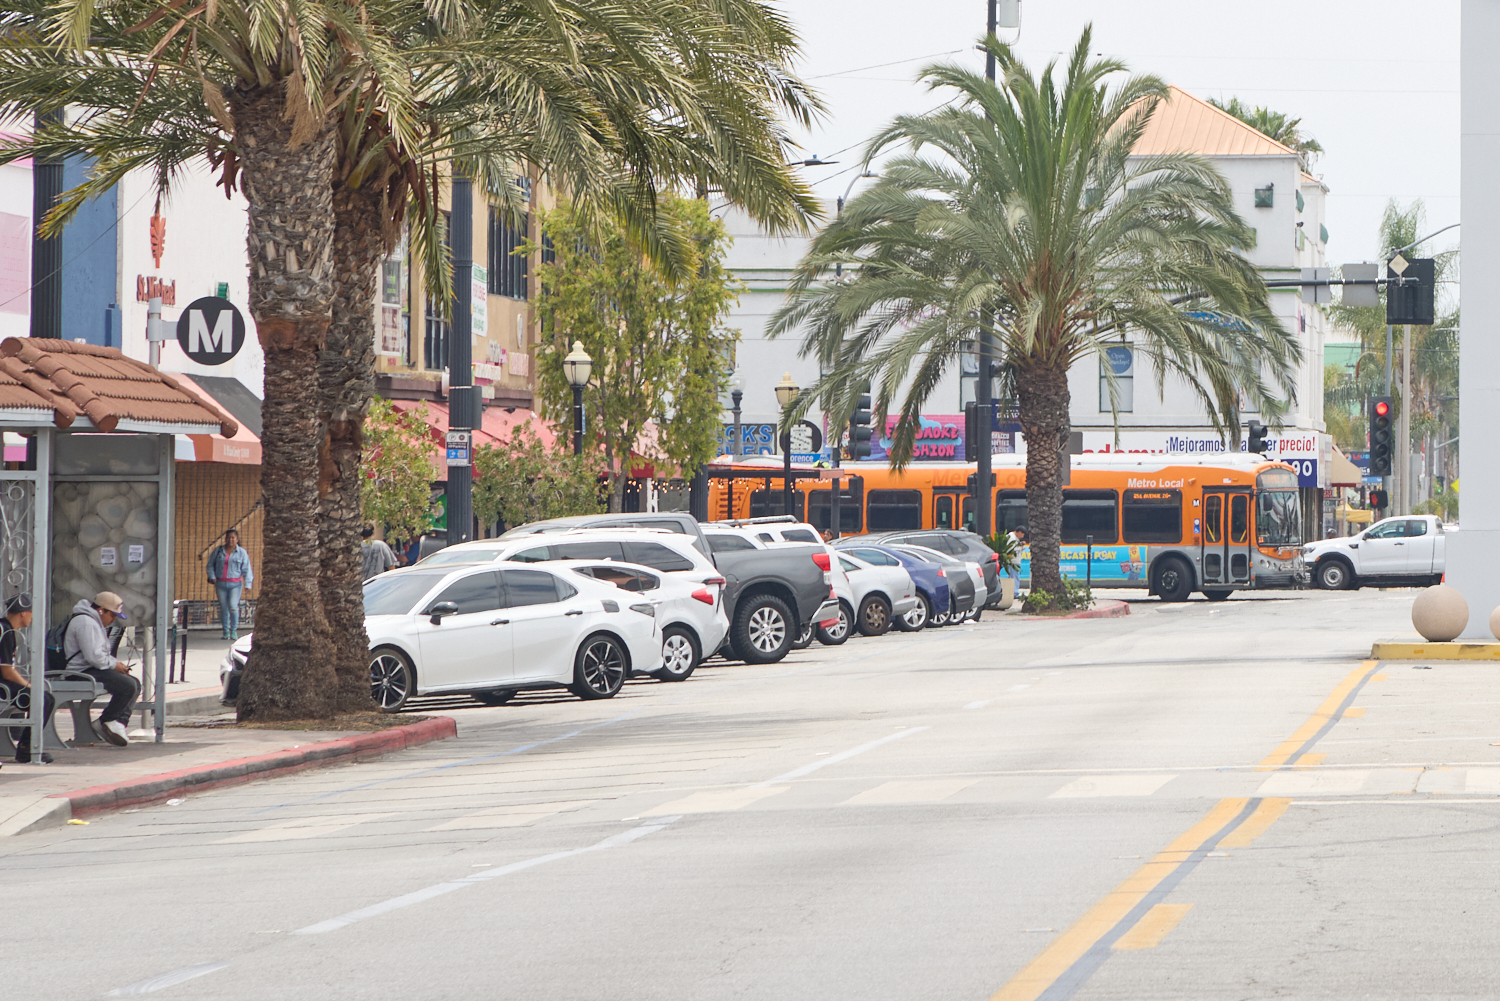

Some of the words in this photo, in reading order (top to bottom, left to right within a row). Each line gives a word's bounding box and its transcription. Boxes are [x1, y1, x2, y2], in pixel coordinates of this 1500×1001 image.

[188, 309, 233, 353] M
[1279, 436, 1316, 457] precio!
[1127, 478, 1157, 488] Metro
[1159, 478, 1184, 488] Local
